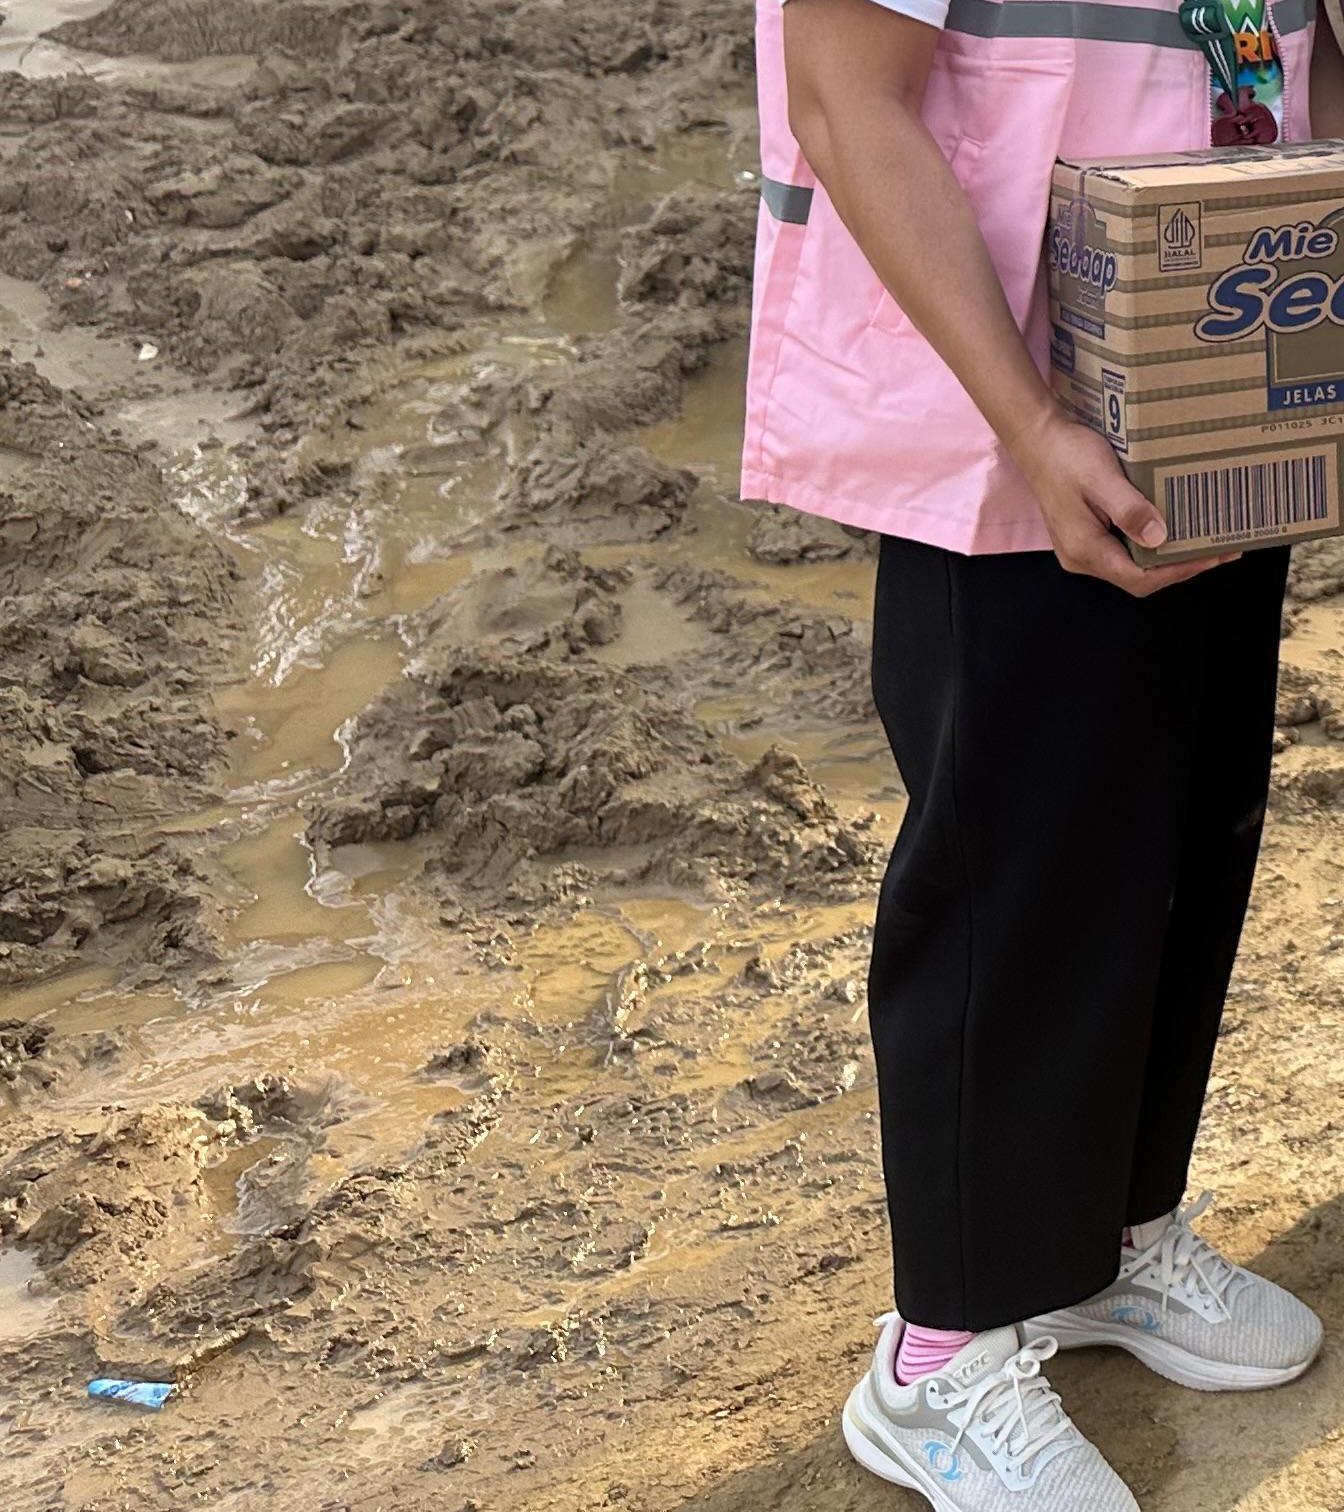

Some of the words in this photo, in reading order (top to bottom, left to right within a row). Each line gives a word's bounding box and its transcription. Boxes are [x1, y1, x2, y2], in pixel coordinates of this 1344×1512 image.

[1164, 248, 1196, 258] HALAL
[1245, 225, 1338, 264] Mie
[1283, 384, 1336, 405] JELAS
[1109, 394, 1120, 434] 9
